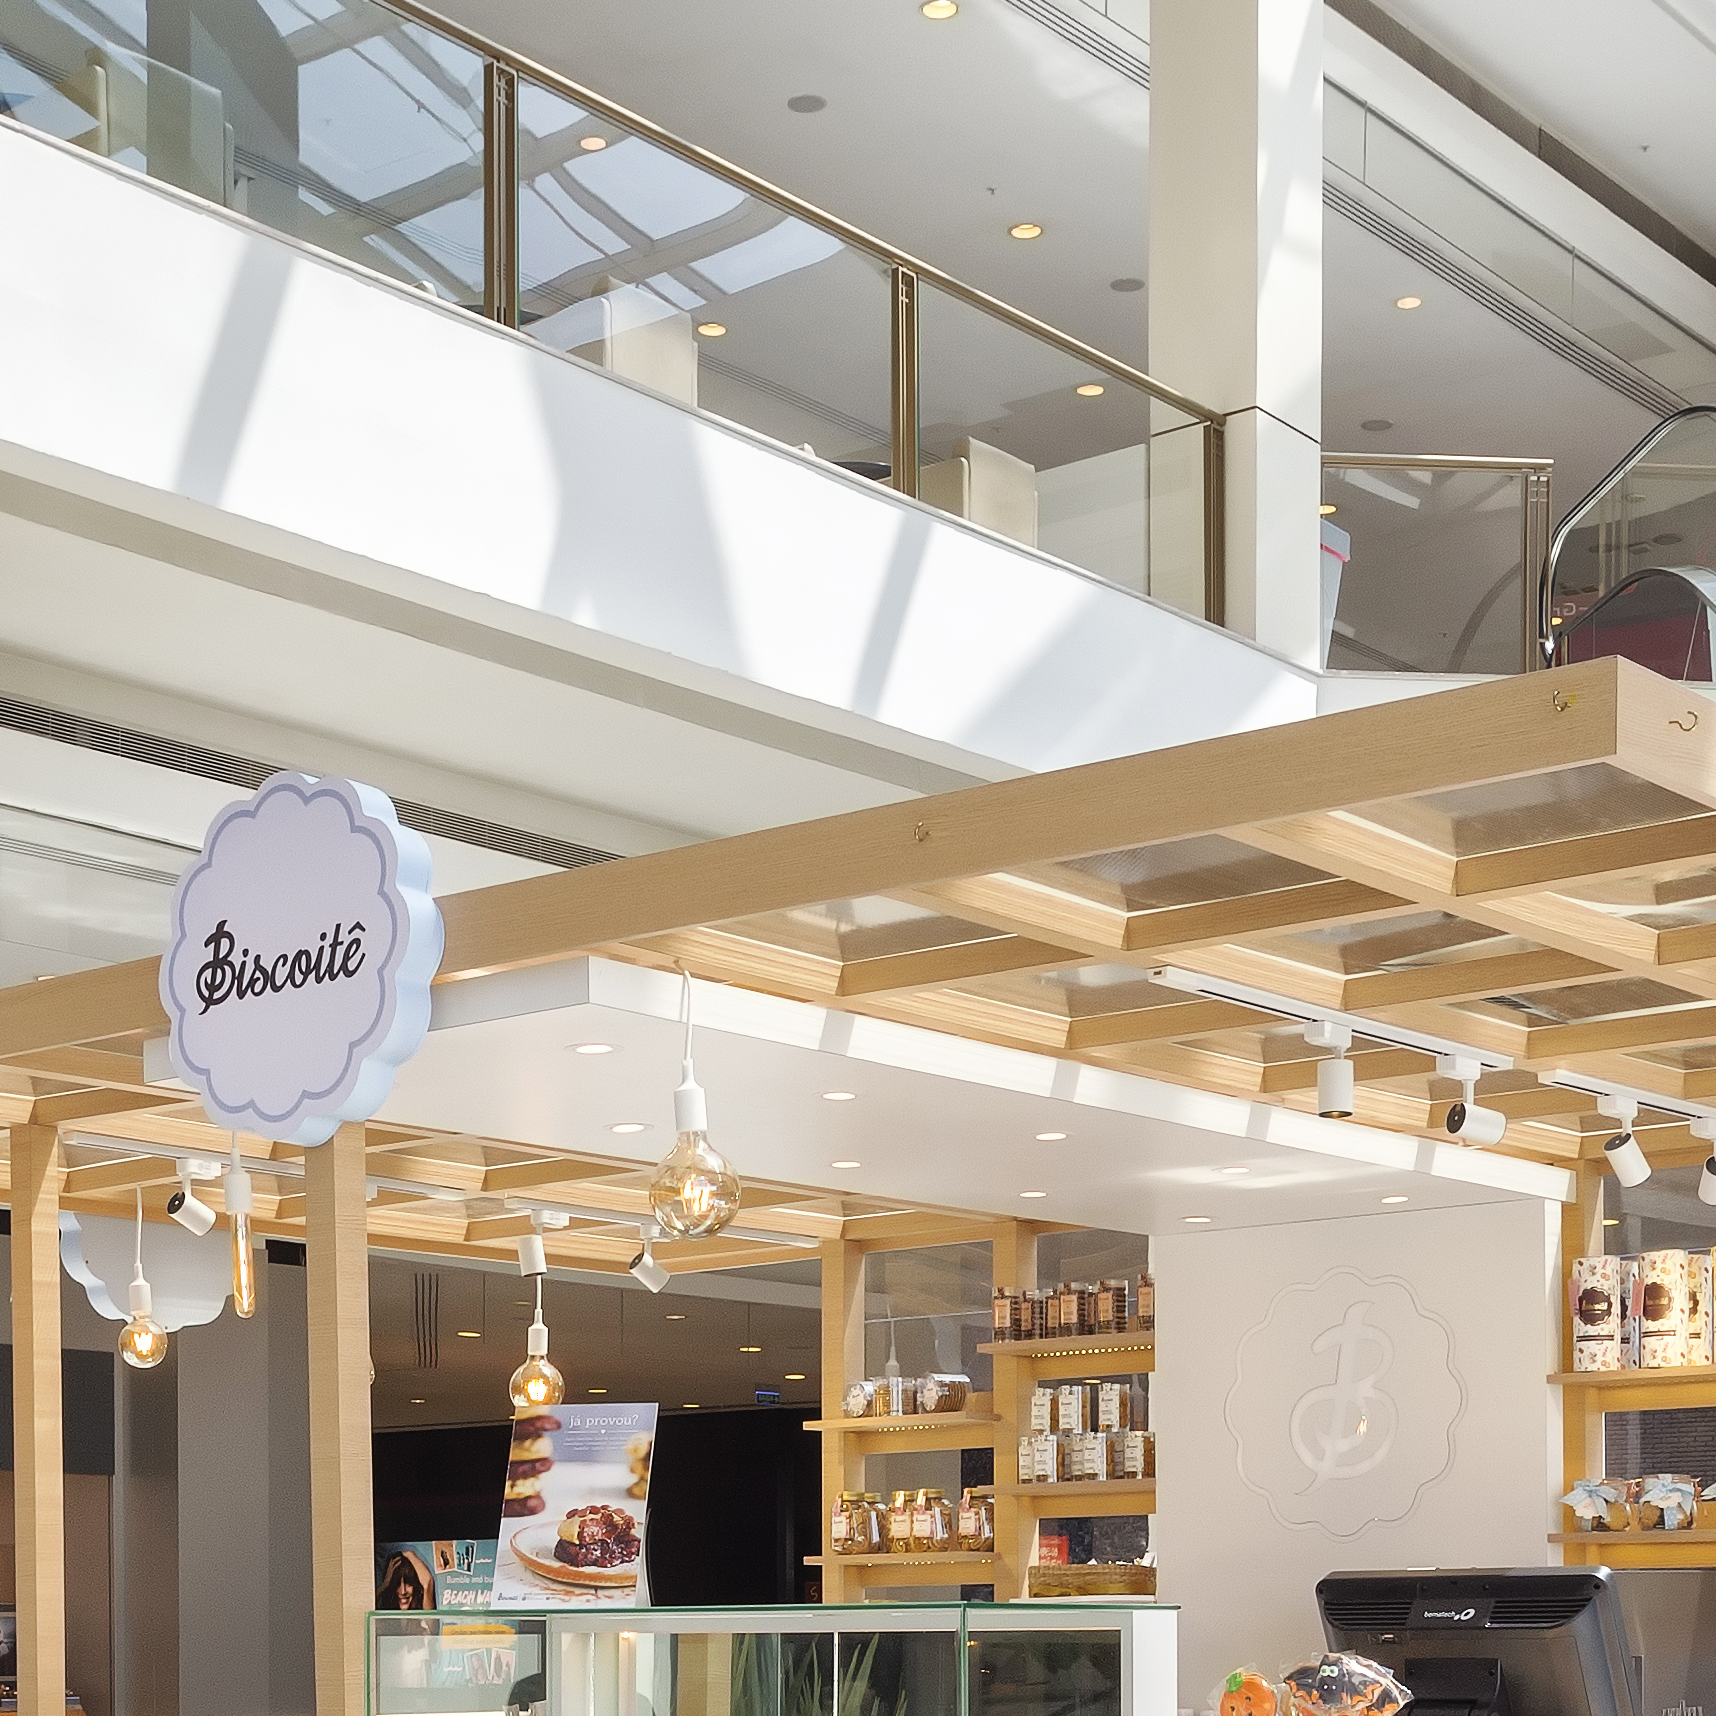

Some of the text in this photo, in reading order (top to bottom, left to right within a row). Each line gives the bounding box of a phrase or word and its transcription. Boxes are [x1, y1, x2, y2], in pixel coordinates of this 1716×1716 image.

[195, 920, 366, 1016] Biscoitê
[569, 1414, 639, 1429] já provou?
[442, 1589, 492, 1605] BEACH WA
